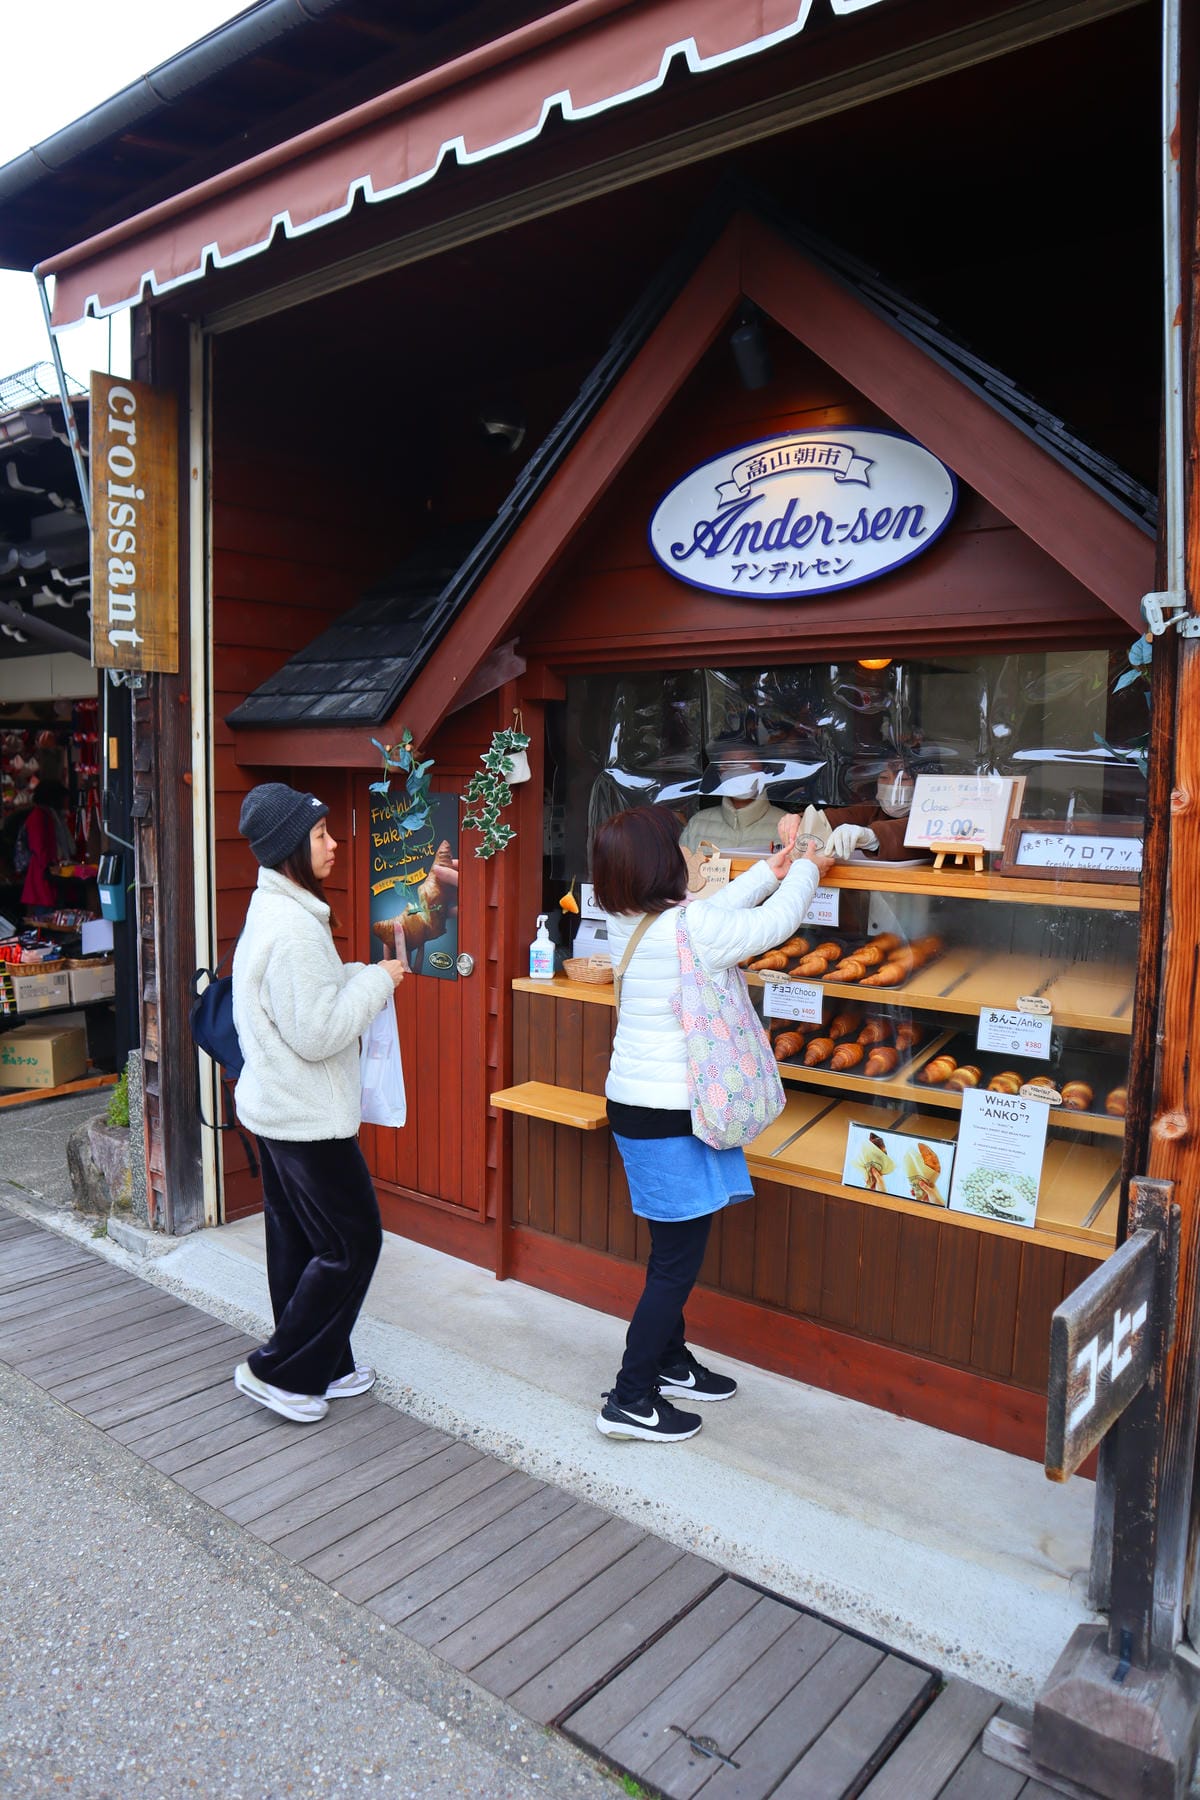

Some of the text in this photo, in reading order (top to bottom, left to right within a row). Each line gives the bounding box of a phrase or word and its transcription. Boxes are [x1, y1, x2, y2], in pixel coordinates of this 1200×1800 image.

[746, 447, 842, 480] 高山朝市
[107, 386, 145, 648] croissant
[670, 493, 927, 561] Ander-sen
[731, 557, 854, 583] アンデルセン
[989, 1012, 1043, 1029] あんこ/Anko
[985, 1095, 1027, 1110] WHAT'S
[1069, 1301, 1148, 1432] コーヒー
